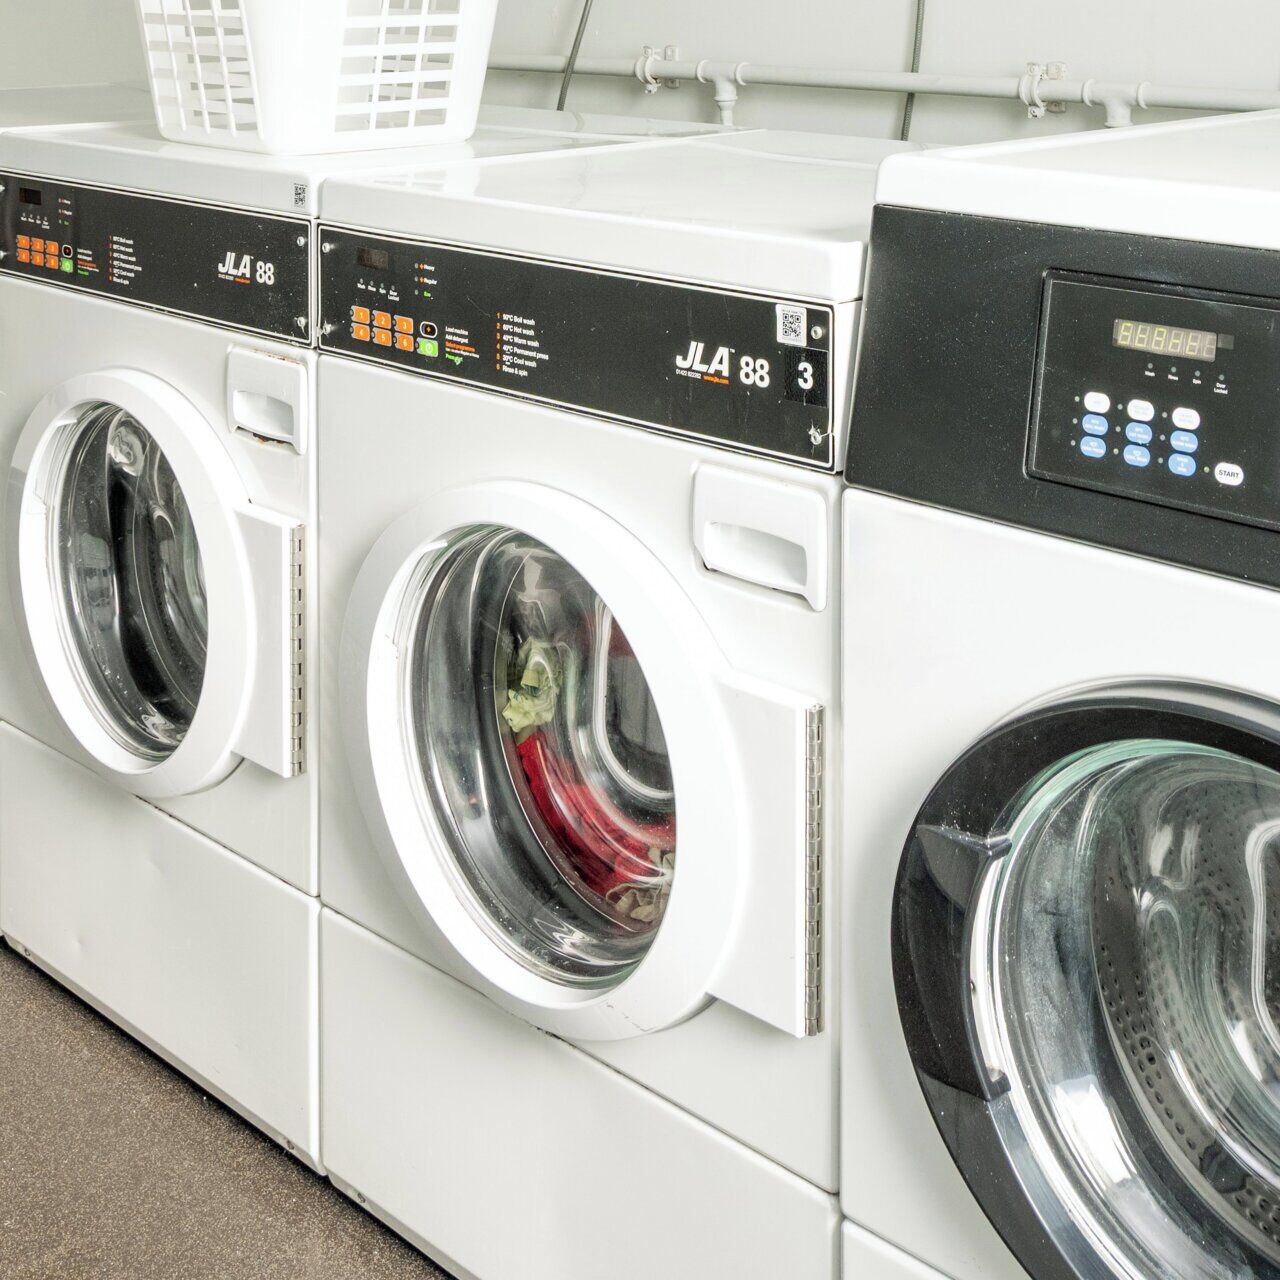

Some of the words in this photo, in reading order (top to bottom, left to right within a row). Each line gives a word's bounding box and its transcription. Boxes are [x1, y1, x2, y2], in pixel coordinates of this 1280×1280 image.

[218, 252, 250, 278] JLA
[256, 261, 274, 285] 88
[676, 340, 729, 377] JLA
[740, 356, 770, 388] 88
[798, 362, 814, 390] 3
[1218, 470, 1240, 478] START
